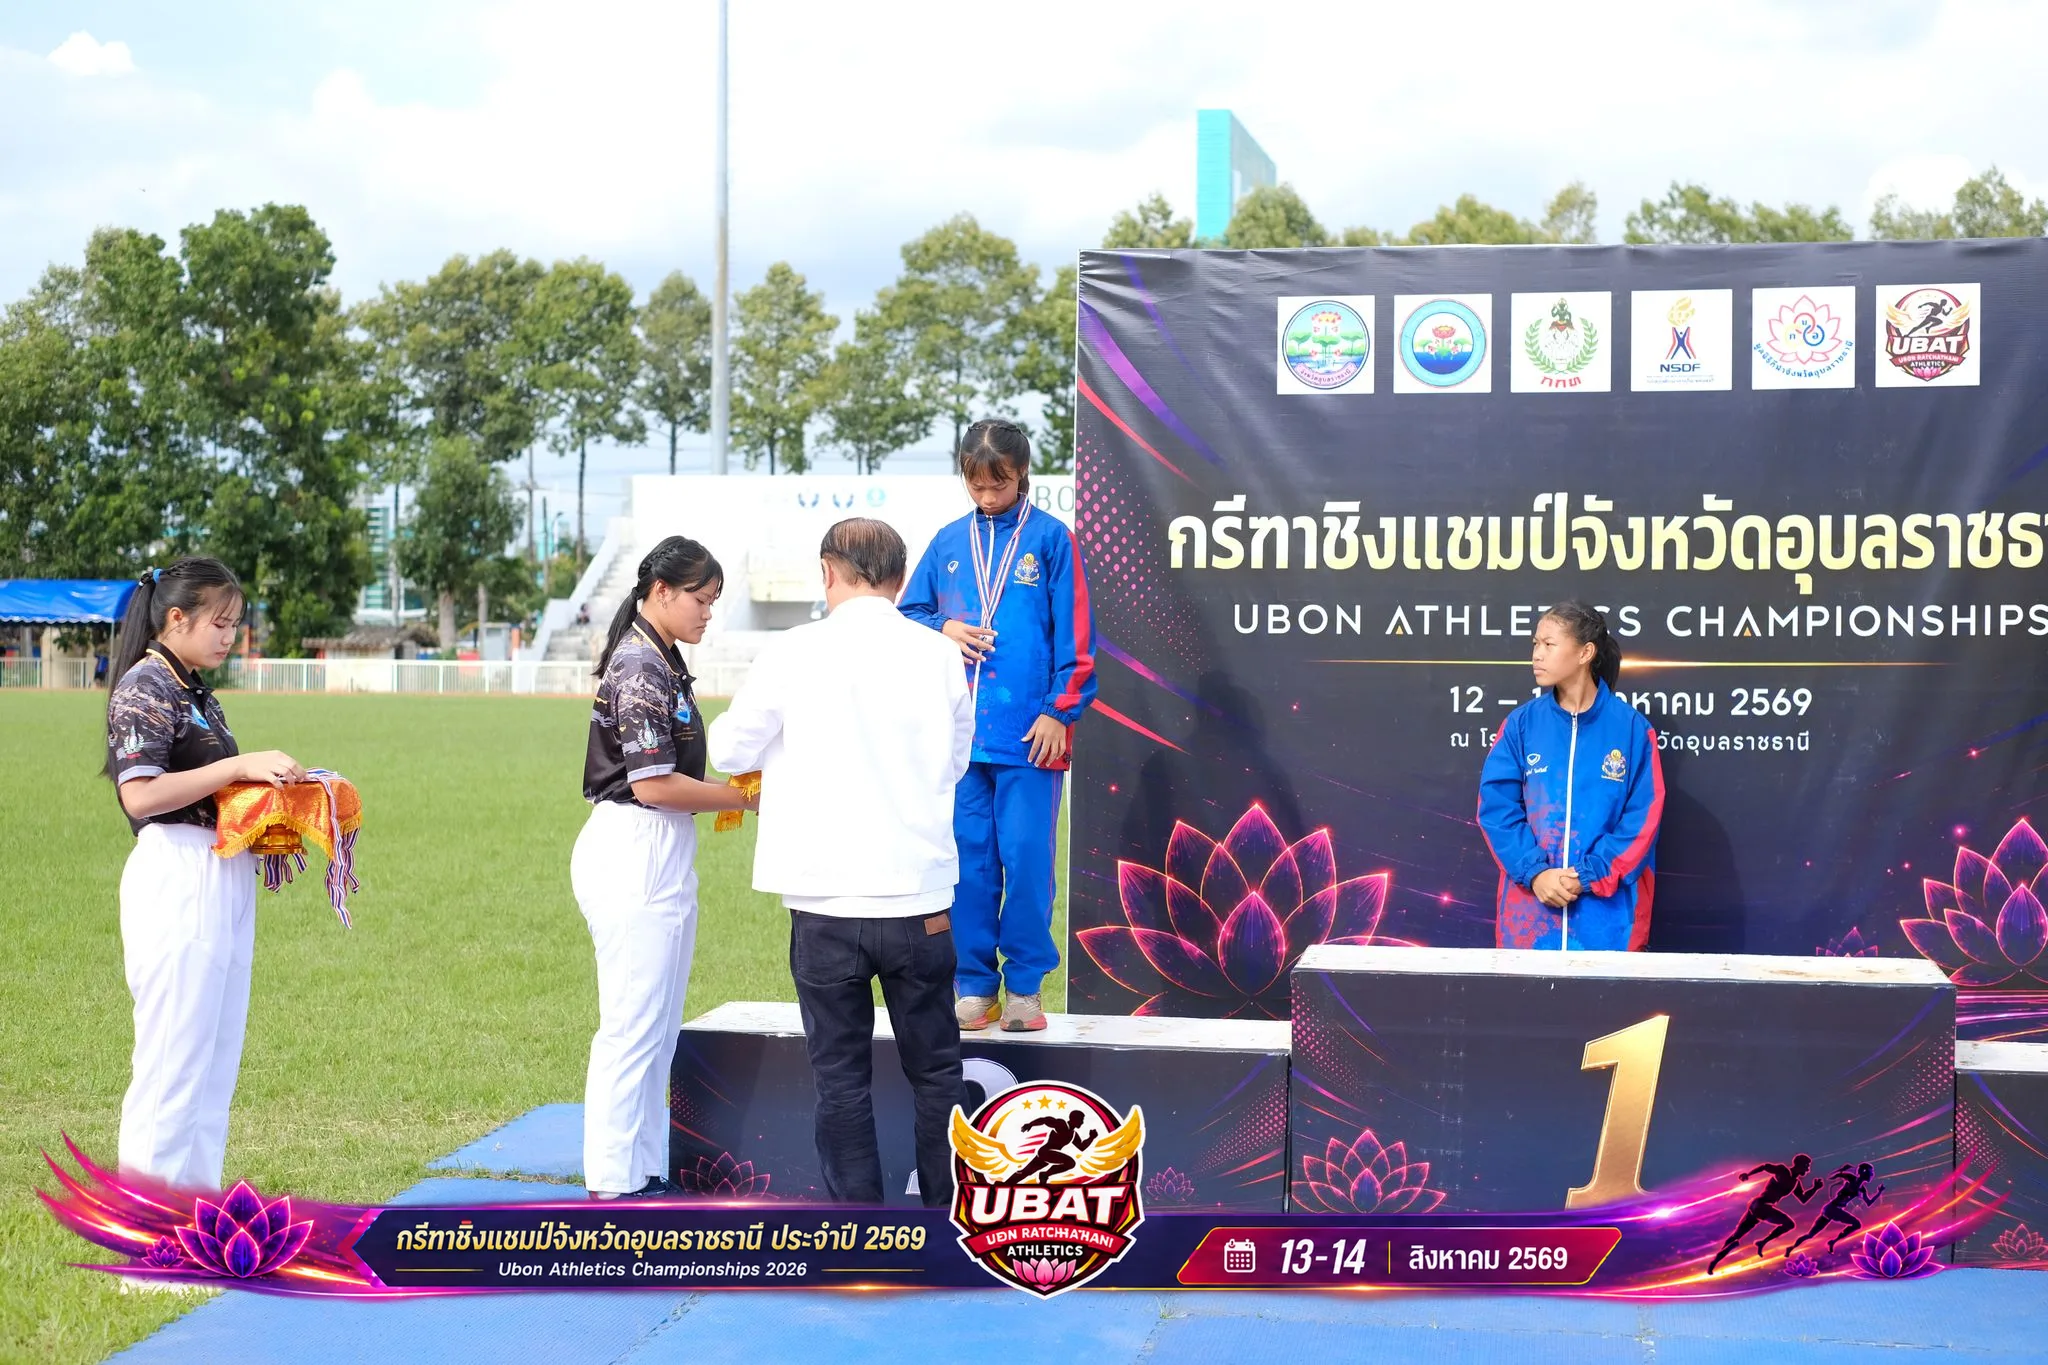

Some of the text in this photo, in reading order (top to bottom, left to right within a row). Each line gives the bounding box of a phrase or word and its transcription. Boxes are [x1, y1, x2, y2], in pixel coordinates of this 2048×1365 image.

[1892, 335, 1964, 355] UBAT
[1660, 363, 1701, 373] NSDF
[1910, 360, 1946, 368] ATHLETICS
[1168, 492, 2048, 595] กรีฑาชิงแชมป์จังหวัดอุบลราชธ
[1234, 604, 2048, 637] UBON ATHLES CHAMPIONSHIPS
[1450, 686, 1484, 713] 12
[1730, 688, 1813, 716] 2569
[1450, 732, 1469, 748] ณ
[1565, 1015, 1670, 1211] 1
